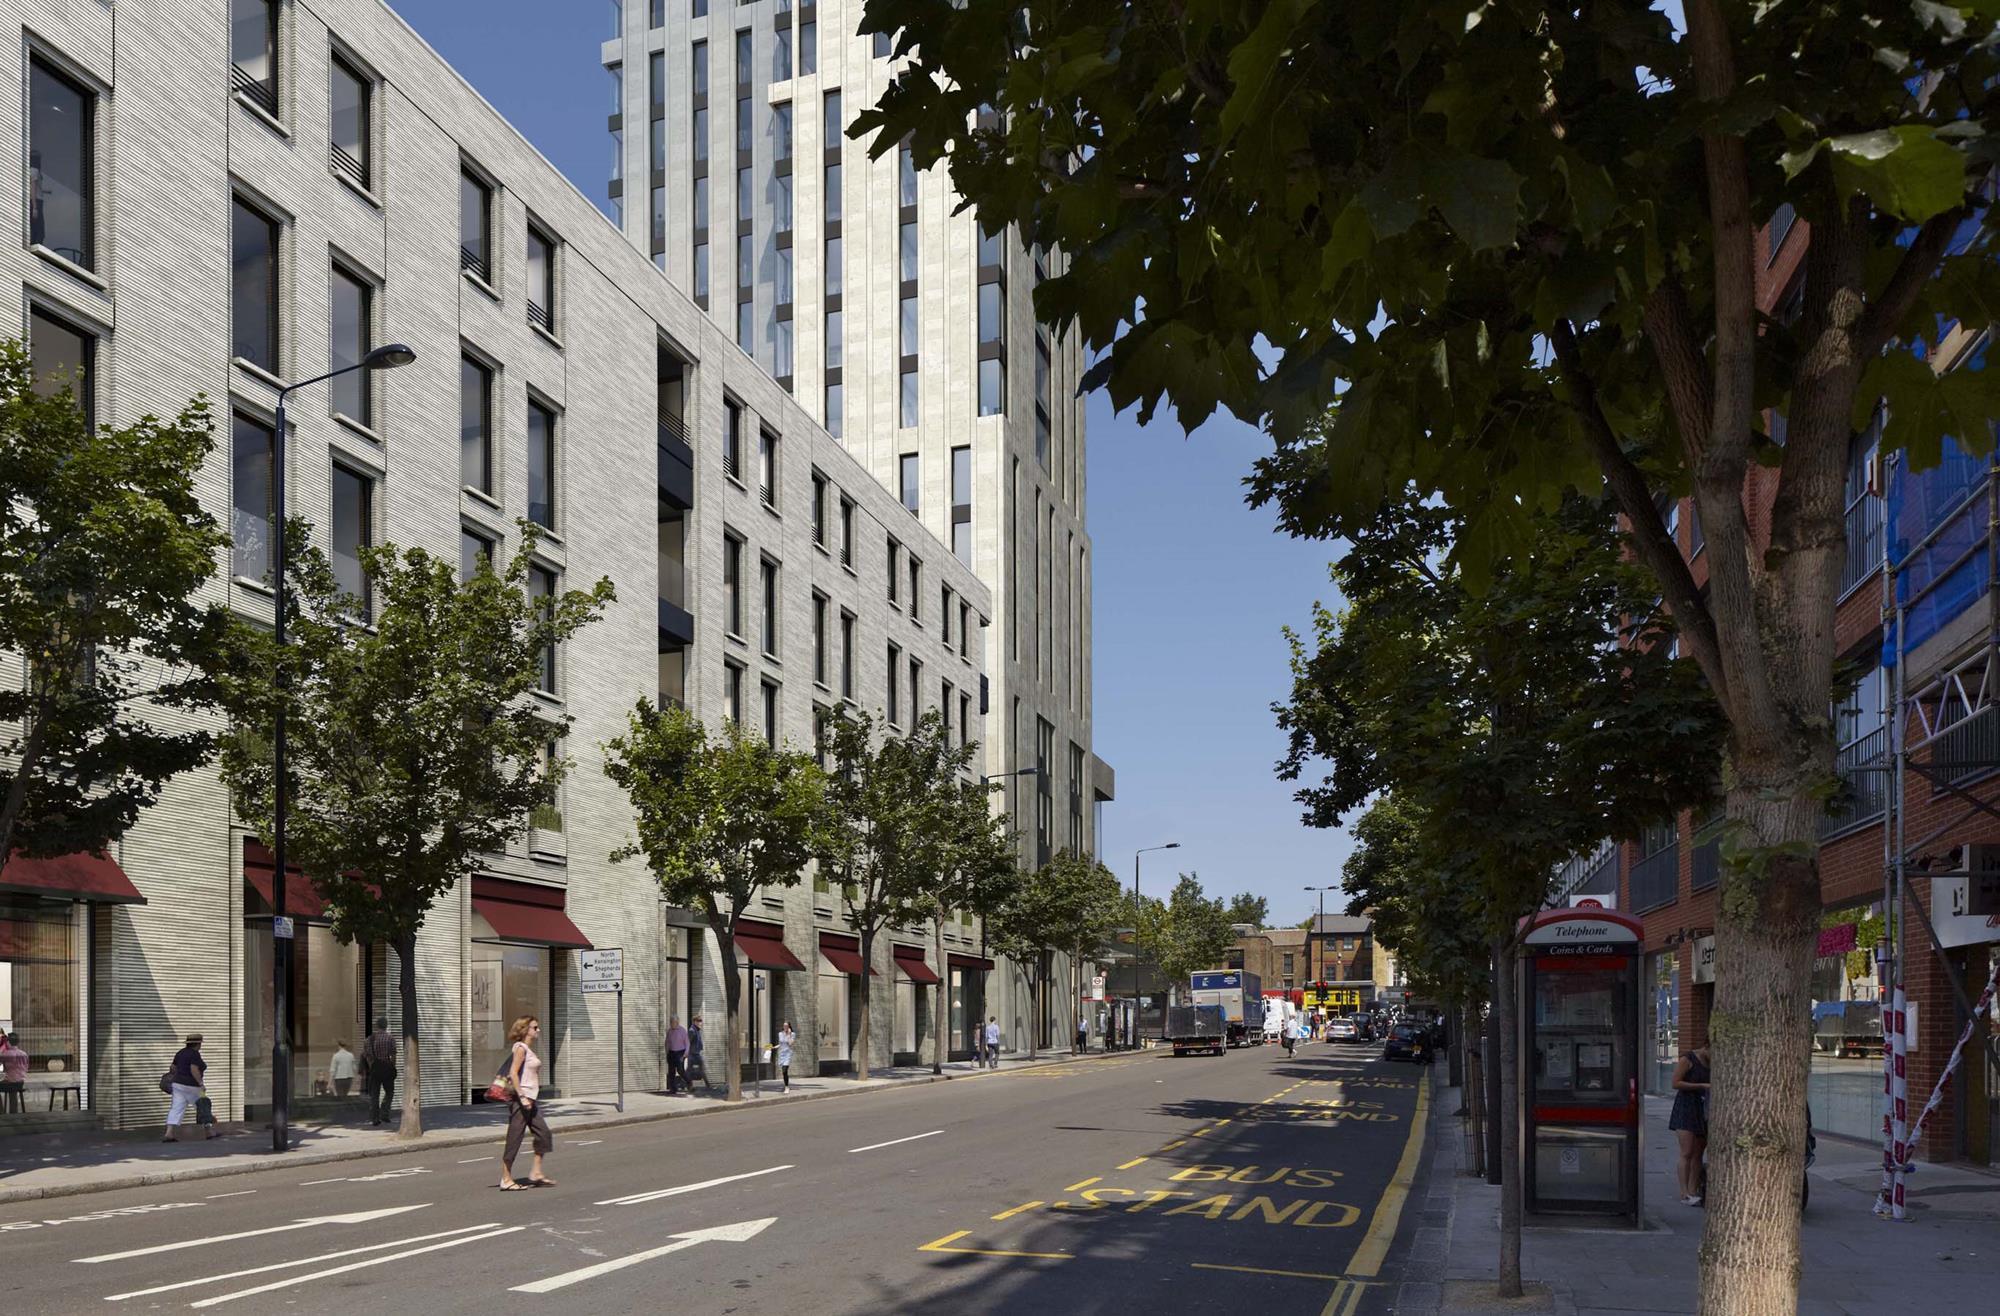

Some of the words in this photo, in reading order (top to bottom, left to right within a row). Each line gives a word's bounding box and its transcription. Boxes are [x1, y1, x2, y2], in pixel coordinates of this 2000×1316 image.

[1555, 925, 1608, 938] Telephone
[1550, 945, 1575, 955] Coins
[1576, 945, 1585, 953] &
[1586, 944, 1613, 953] Cards
[1300, 1099, 1384, 1109] BUS
[1251, 1109, 1399, 1122] STAND
[1168, 1165, 1344, 1188] BUS
[1053, 1188, 1361, 1228] STAND
